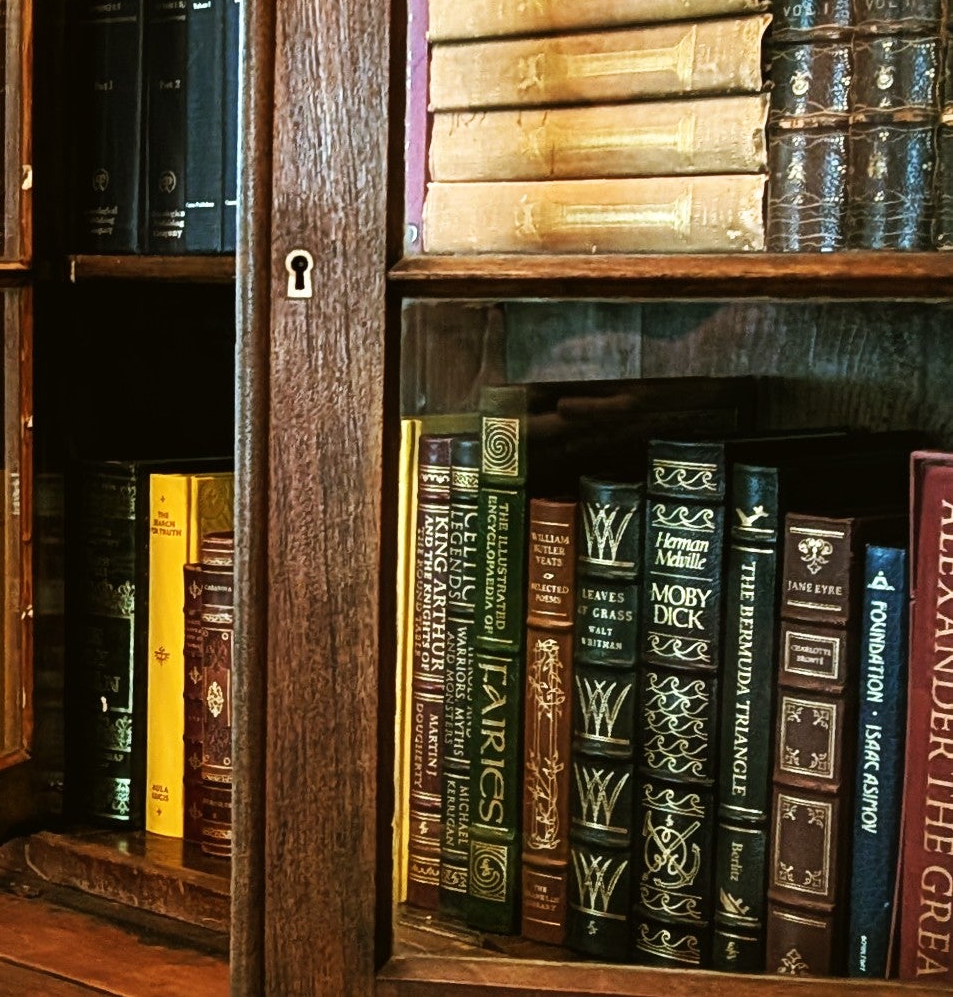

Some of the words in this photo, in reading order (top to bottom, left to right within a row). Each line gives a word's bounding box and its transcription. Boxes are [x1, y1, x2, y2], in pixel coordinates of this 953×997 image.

[425, 515, 434, 548] AND
[499, 503, 509, 531] THE
[531, 532, 569, 544] WILLIAM
[424, 550, 433, 579] THE
[434, 517, 449, 573] KING
[449, 511, 463, 599] LEGENDS
[485, 495, 497, 610] ENCYCLOPAEDIA
[536, 556, 562, 567] YEATS
[655, 532, 709, 552] Herman
[655, 550, 706, 570] Melville
[496, 535, 508, 629] ILLUSTRATED
[582, 589, 624, 603] LEAVES
[650, 583, 712, 608] MOBY
[740, 562, 756, 601] THE
[787, 580, 813, 593] JANE
[814, 583, 842, 596] EYRE
[422, 584, 431, 648] KNIGHTS
[431, 579, 446, 671] ARTHUR
[484, 615, 494, 634] OF
[588, 626, 612, 636] WALT
[592, 608, 632, 621] GRASS
[654, 605, 704, 630] DICK
[421, 652, 430, 671] OF
[735, 604, 755, 697] BERMUDA
[869, 601, 888, 703] FOUNDATION
[444, 671, 454, 745] MONSTERS
[454, 708, 464, 756] MYTHS
[414, 703, 423, 788] DOUGHERTY
[429, 714, 438, 763] MARTIN
[478, 663, 507, 824] FAIRIES
[731, 701, 750, 796] TRIANGLE
[864, 724, 881, 771] ISAAC
[445, 780, 456, 847] KERRIGAN
[458, 785, 469, 844] MICHAEL
[861, 772, 880, 834] ASIMOV
[924, 775, 953, 856] THE
[730, 841, 743, 881] Berlitz
[916, 866, 953, 976] GREA
